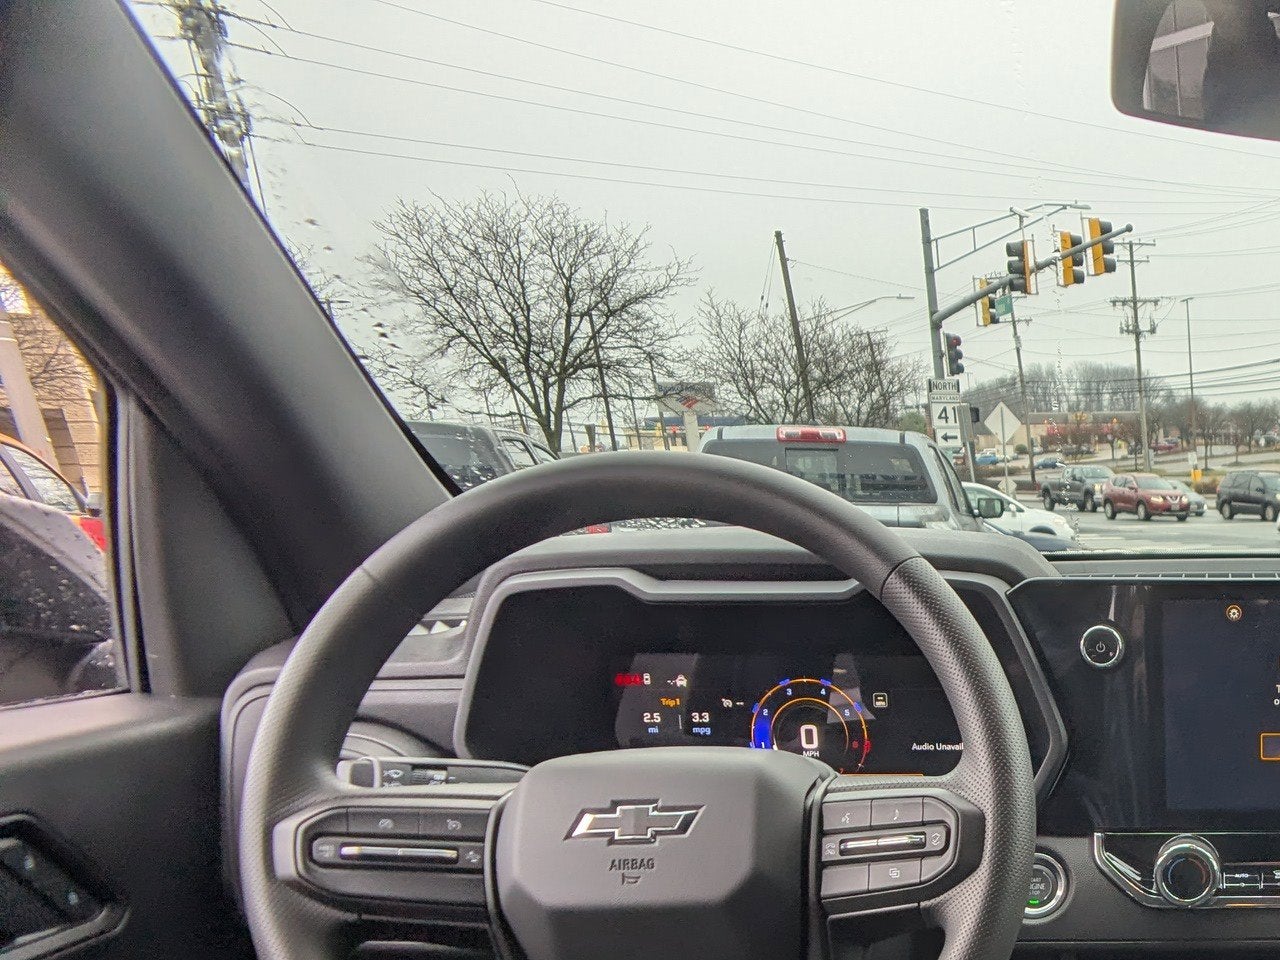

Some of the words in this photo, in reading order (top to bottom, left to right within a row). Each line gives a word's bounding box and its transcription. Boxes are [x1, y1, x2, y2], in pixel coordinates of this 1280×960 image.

[932, 381, 956, 390] NORTH
[938, 406, 958, 424] 41
[660, 698, 675, 708] Trip
[643, 712, 661, 723] 2.5
[692, 712, 710, 723] 3.3
[692, 727, 711, 735] mpg
[800, 724, 818, 749] 0
[608, 857, 655, 872] AIRBAG
